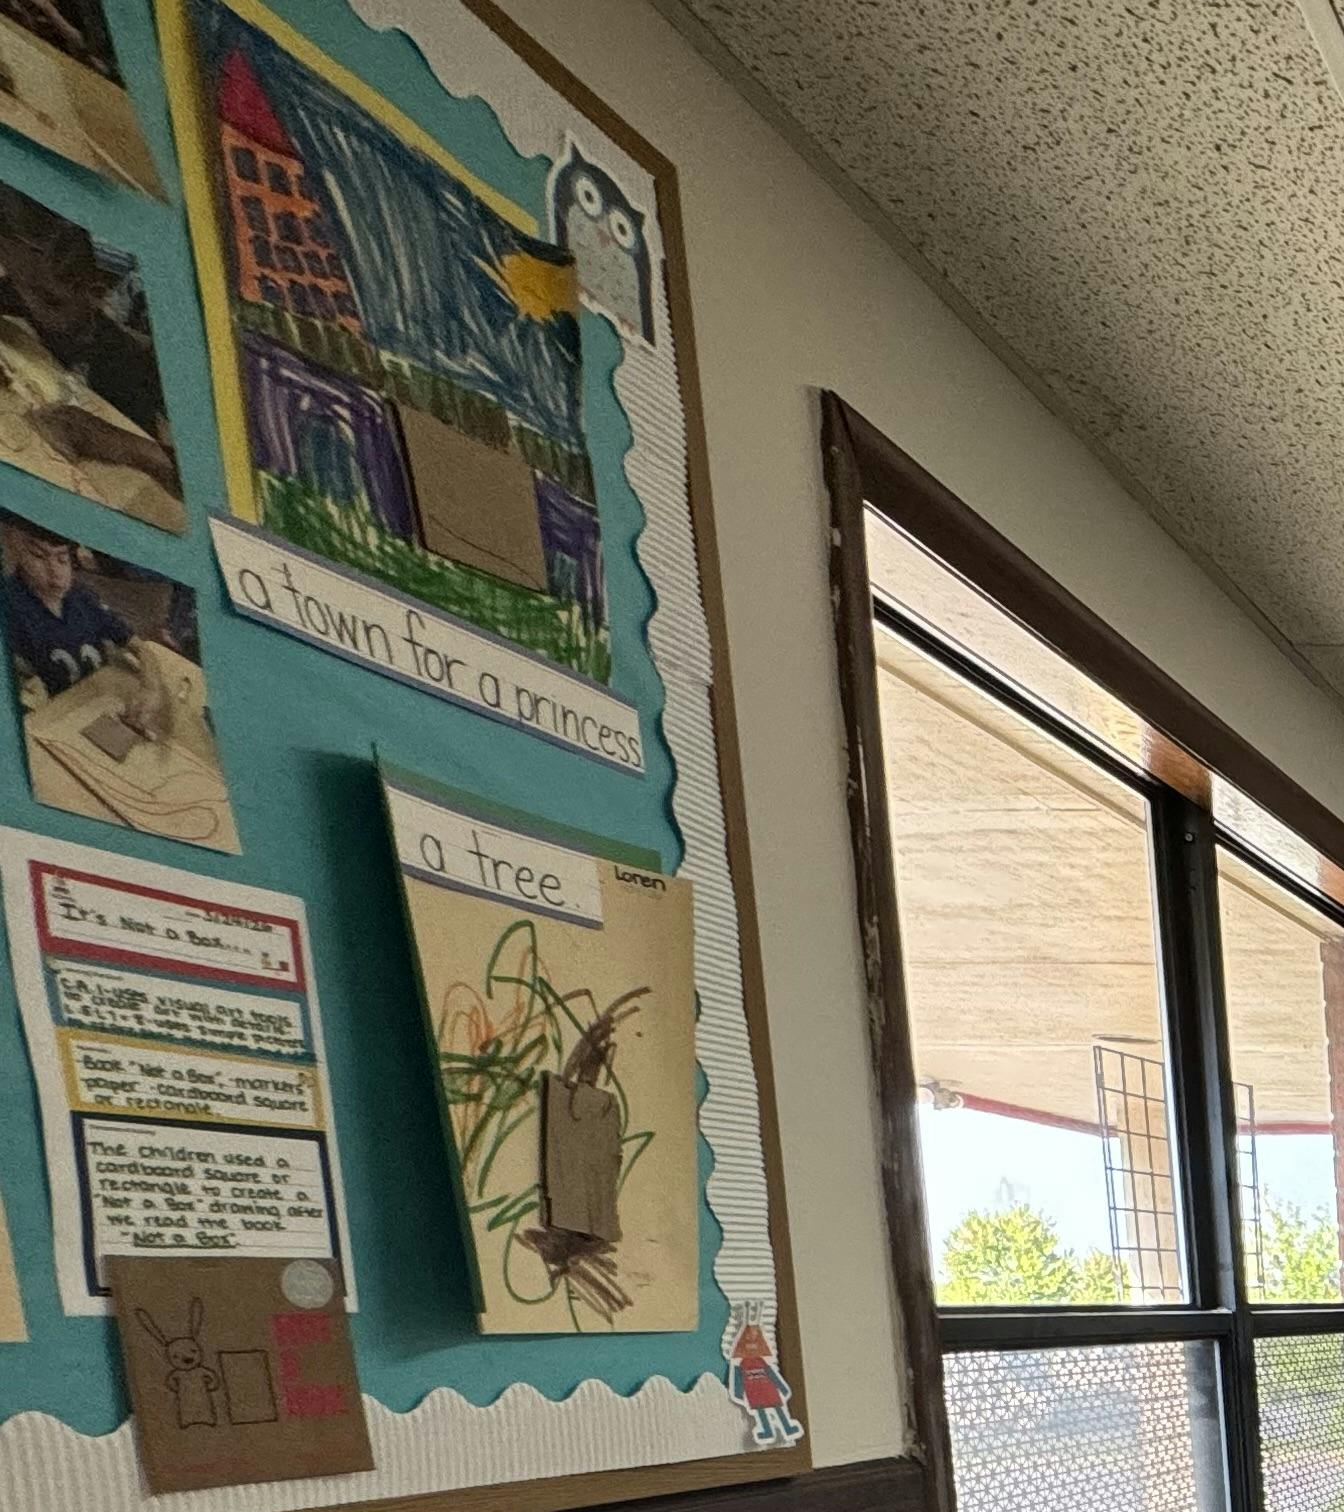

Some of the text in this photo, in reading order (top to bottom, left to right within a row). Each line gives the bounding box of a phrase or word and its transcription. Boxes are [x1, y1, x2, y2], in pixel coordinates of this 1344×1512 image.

[237, 561, 643, 768] a town for a princess
[419, 833, 447, 873] a
[612, 863, 667, 892] Loren
[165, 927, 181, 941] a
[252, 1094, 309, 1112] square
[87, 1141, 290, 1169] The children used a
[96, 1161, 291, 1185] cardboard square or
[98, 1178, 310, 1202] rectangle to create a
[209, 1201, 280, 1219] drawing
[143, 1216, 287, 1232] read the book
